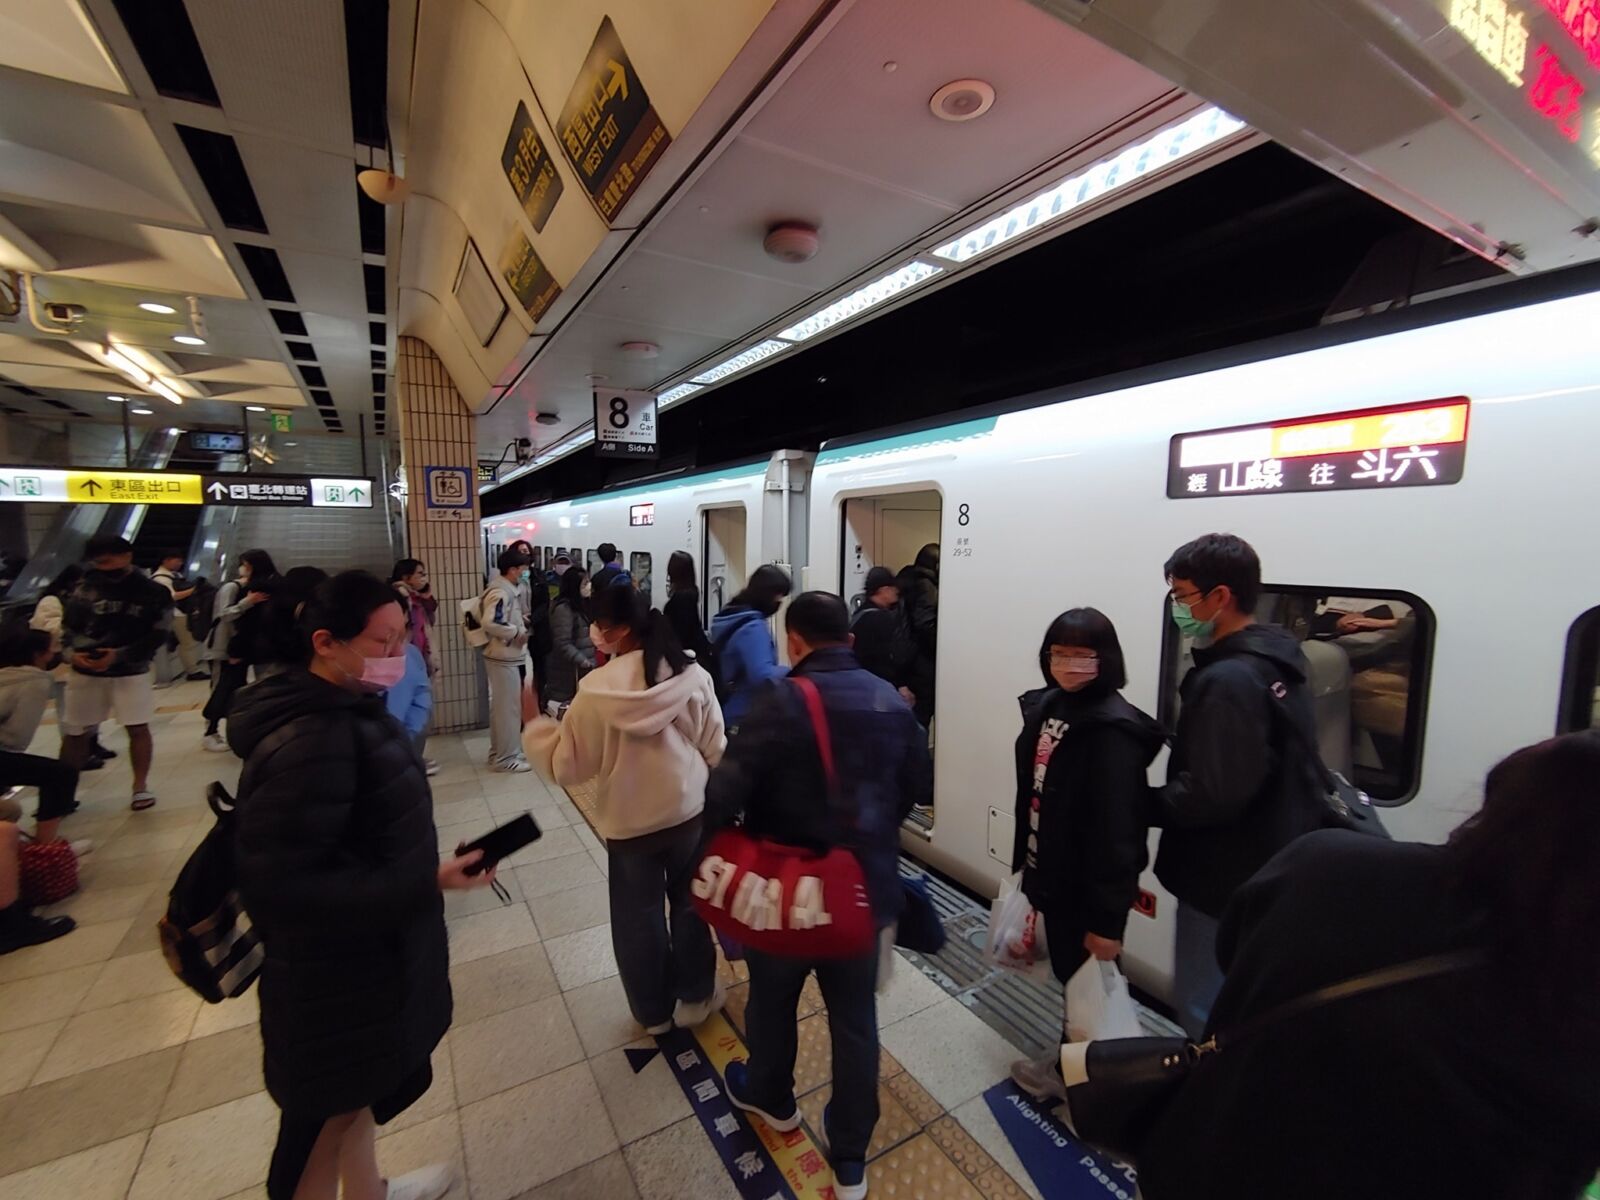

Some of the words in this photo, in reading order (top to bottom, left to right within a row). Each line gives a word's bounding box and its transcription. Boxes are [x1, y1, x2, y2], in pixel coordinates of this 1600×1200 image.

[582, 148, 605, 178] WEST
[599, 114, 620, 156] EXIT
[546, 159, 555, 178] 3
[609, 396, 630, 429] 8
[641, 412, 652, 422] 車
[639, 422, 654, 431] Car
[627, 443, 646, 453] Side
[647, 444, 654, 453] A
[1218, 458, 1284, 492] 山線
[1308, 462, 1336, 486] 往
[1350, 445, 1440, 483] 斗六
[109, 478, 181, 493] 東區出口
[111, 491, 137, 500] East
[137, 492, 159, 501] Exit
[958, 503, 970, 527] 8
[1005, 1094, 1068, 1148] Alighting
[1079, 1155, 1133, 1200] Passe
[786, 1168, 804, 1192] the
